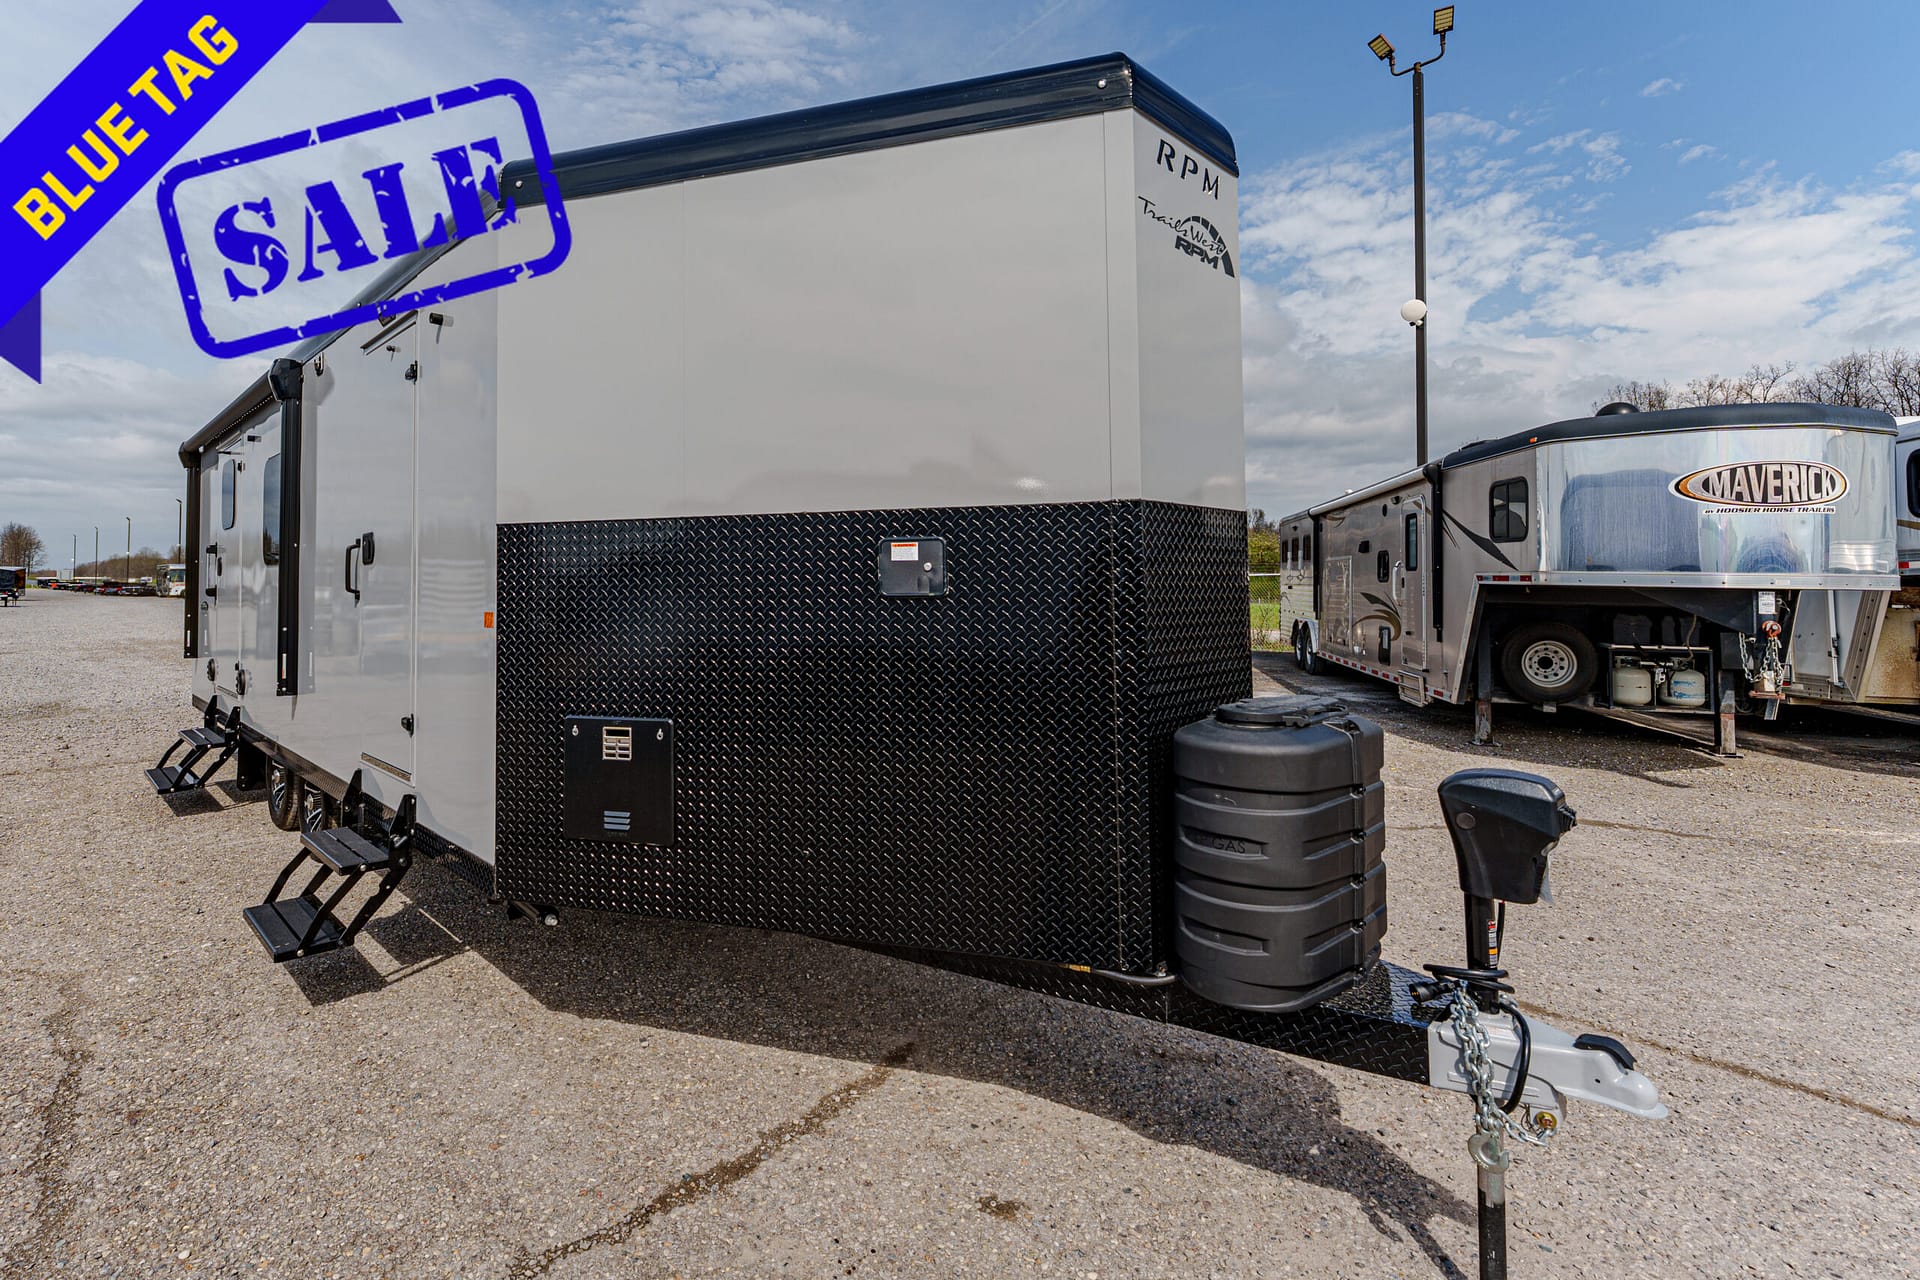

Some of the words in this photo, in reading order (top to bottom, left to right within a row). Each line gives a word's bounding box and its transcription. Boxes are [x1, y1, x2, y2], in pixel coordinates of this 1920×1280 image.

[1156, 138, 1220, 200] RPM
[1137, 195, 1188, 236] Trails
[1174, 235, 1218, 269] RPM
[1708, 464, 1834, 503] MAVERICK
[1212, 838, 1246, 854] GAS
